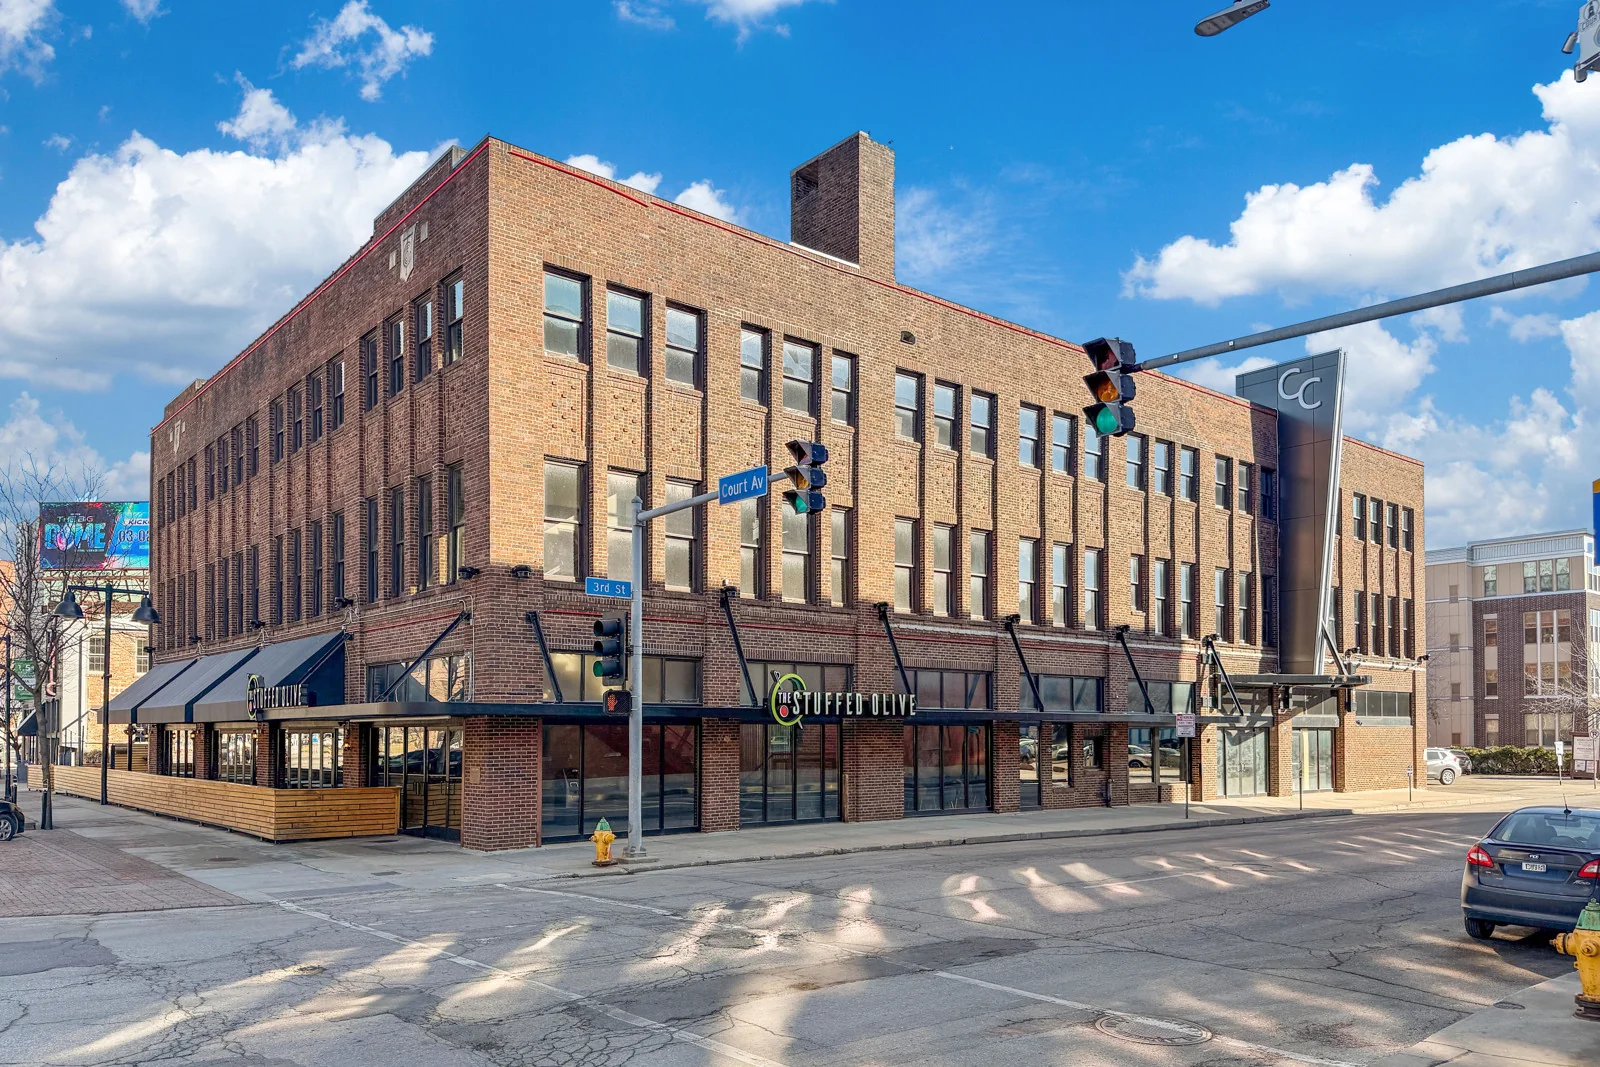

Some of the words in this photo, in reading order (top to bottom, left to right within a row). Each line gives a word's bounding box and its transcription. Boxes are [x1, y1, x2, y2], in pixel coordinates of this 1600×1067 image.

[721, 478, 748, 498] Court
[751, 475, 764, 491] Av
[593, 582, 610, 593] 3rd
[615, 584, 626, 595] St
[777, 692, 792, 704] THE
[792, 691, 863, 715] STUFFED
[871, 693, 916, 716] OLIVE
